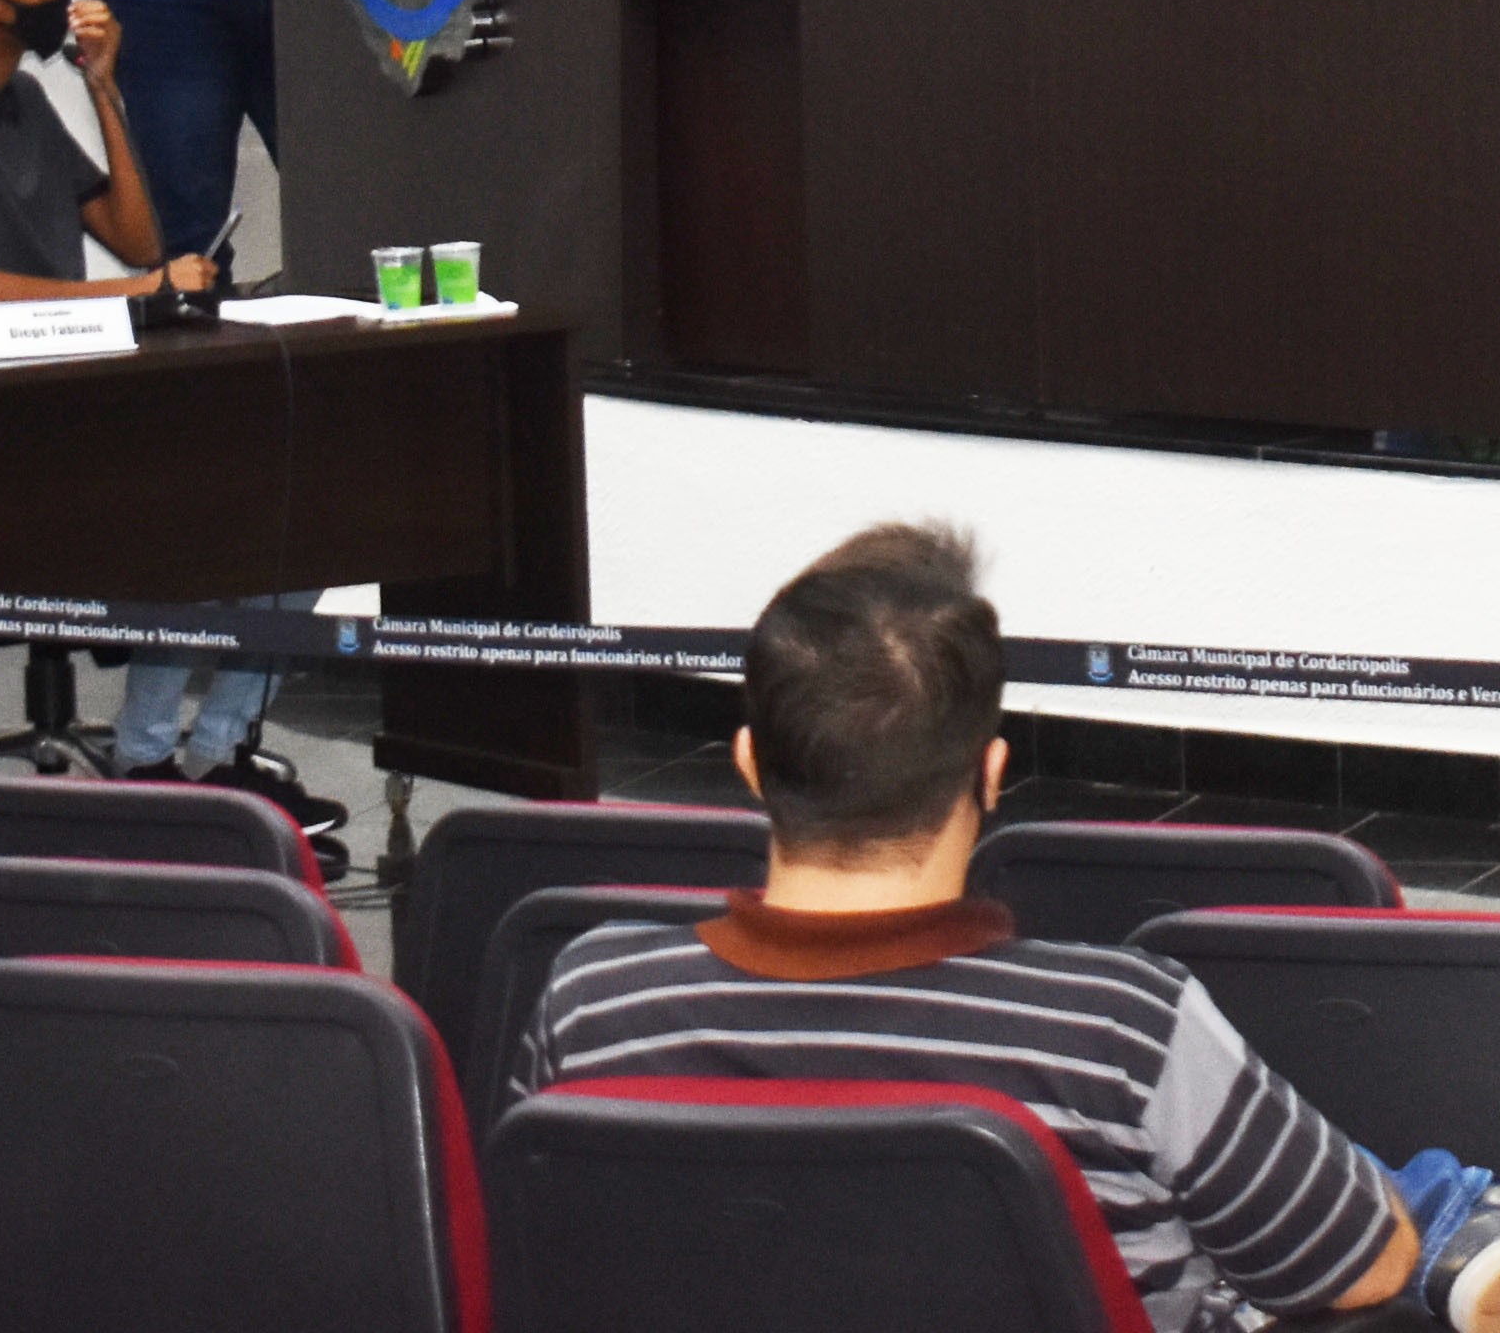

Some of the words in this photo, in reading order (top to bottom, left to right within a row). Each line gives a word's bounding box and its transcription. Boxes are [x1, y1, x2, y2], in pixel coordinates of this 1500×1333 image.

[14, 595, 107, 618] Cordeirópolis
[24, 622, 55, 636] para
[58, 620, 145, 642] funcionários
[147, 630, 156, 641] e
[158, 628, 240, 648] Vereadores.
[372, 616, 426, 633] Câmara
[429, 618, 500, 637] Municipal
[503, 621, 520, 637] de
[523, 622, 622, 642] Cordeirópolis
[372, 640, 421, 656] Acesso
[424, 643, 478, 659] restrito
[481, 648, 531, 664] apenas
[535, 650, 567, 666] para
[570, 648, 662, 666] funcionários
[664, 655, 673, 666] e
[1127, 643, 1188, 663] Câmara
[1192, 646, 1271, 669] Municipal
[1275, 651, 1296, 668] de
[1299, 652, 1409, 677] Cordeirópolis
[1128, 669, 1182, 687] Acesso
[1185, 672, 1247, 691] restrito
[1251, 678, 1306, 697] apenas
[1311, 681, 1348, 699] para
[1351, 678, 1454, 702] funcionários
[1457, 688, 1468, 702] e
